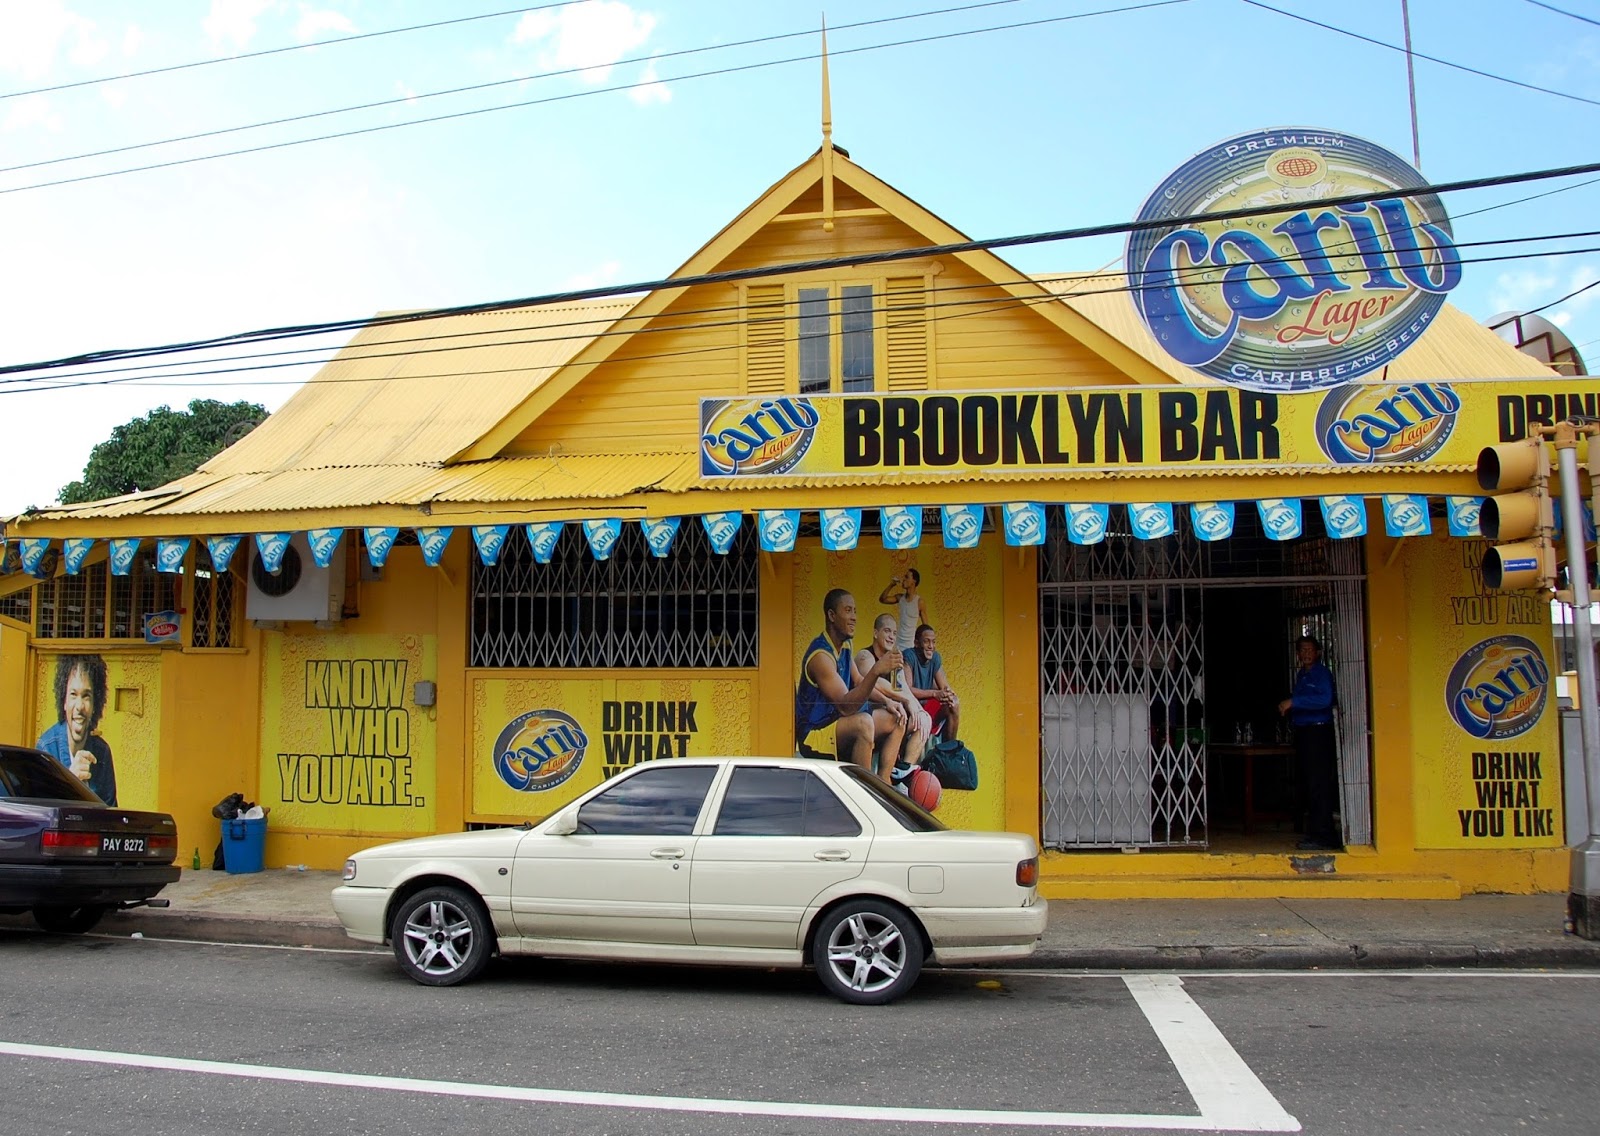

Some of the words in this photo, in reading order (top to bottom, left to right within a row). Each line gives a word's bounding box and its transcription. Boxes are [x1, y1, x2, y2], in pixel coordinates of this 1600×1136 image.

[1225, 136, 1343, 157] PREMIUM
[1142, 199, 1462, 367] Carib
[1276, 290, 1395, 345] Lager
[1230, 352, 1377, 383] CARIBBEAN
[1387, 311, 1431, 352] BEER
[844, 393, 1143, 467] BROOKLYN
[1158, 390, 1281, 462] BAR
[1391, 419, 1435, 453] Lager
[1497, 393, 1600, 443] DRIN
[753, 434, 797, 466] Lager
[1450, 596, 1498, 625] YOU
[1506, 596, 1541, 624] ARE
[305, 659, 408, 708] KNOW
[1454, 654, 1548, 737] Carib
[330, 707, 409, 757] WHO
[602, 701, 698, 732] DRINK
[499, 724, 588, 790] Carib
[603, 733, 691, 765] WHAT
[1471, 752, 1542, 780] DRINK
[277, 754, 342, 804] YOU
[347, 755, 425, 807] ARE.
[1475, 781, 1539, 808] WHAT
[1458, 809, 1504, 837] YOU
[1513, 809, 1553, 837] LIKE
[103, 838, 121, 851] PAY
[124, 839, 144, 852] 8272
